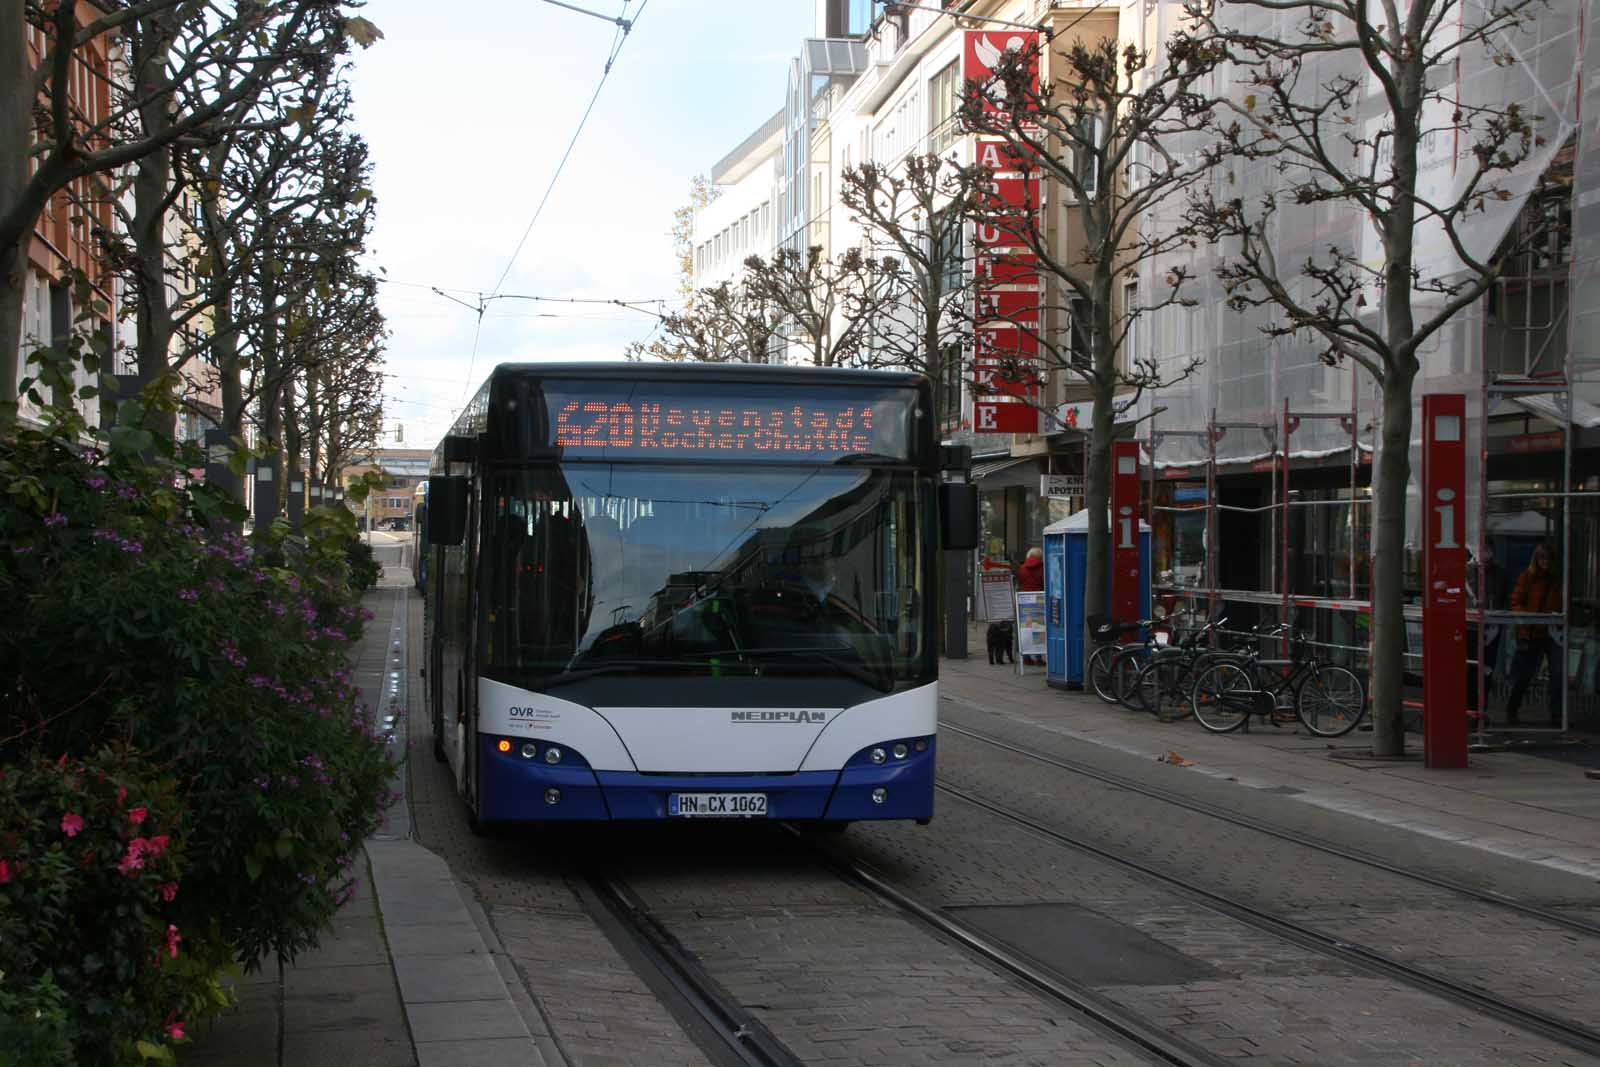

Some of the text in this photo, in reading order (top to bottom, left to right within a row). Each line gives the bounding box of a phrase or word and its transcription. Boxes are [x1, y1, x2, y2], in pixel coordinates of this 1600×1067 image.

[557, 400, 633, 447] 620
[641, 403, 873, 428] Neuenstadt
[509, 706, 534, 717] OVR
[731, 710, 826, 723] NEOPLAN
[680, 796, 766, 812] HN CX 1062
